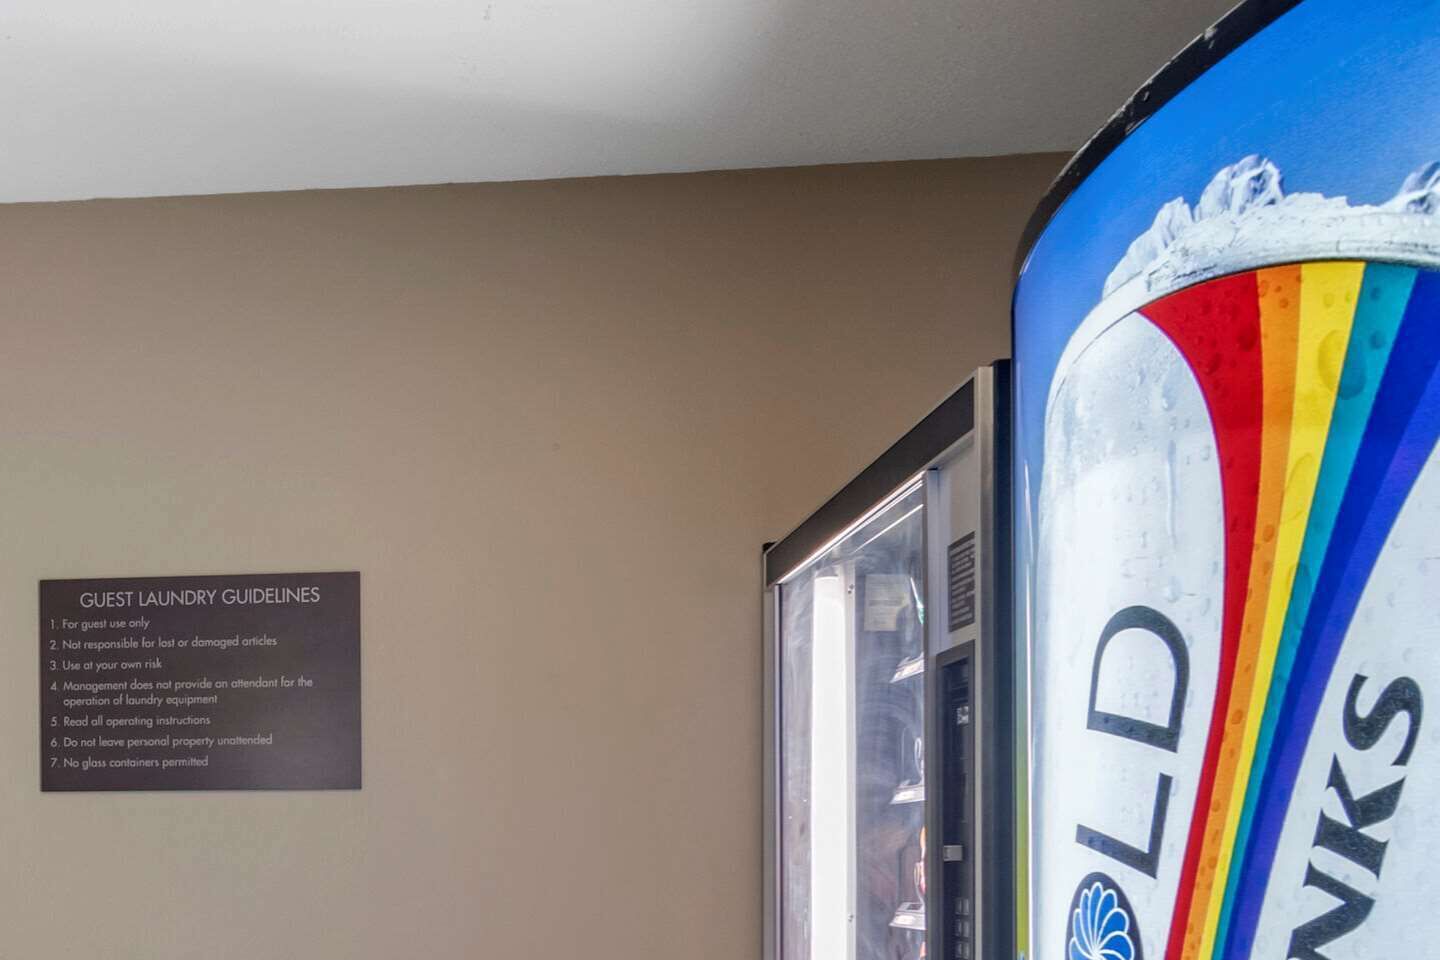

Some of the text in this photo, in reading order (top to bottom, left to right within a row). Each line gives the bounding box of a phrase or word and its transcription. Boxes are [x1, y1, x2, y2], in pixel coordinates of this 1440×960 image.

[80, 586, 320, 608] GUEST LAUNDRY GUIDELINES
[62, 619, 78, 629] For
[81, 619, 106, 631] guest
[110, 621, 127, 629] use
[128, 616, 150, 630] only
[62, 640, 81, 649] Not
[83, 637, 138, 651] responsible
[142, 636, 155, 648] for
[158, 636, 175, 648] lost
[191, 635, 239, 649] damaged
[242, 634, 278, 646] articles
[62, 660, 80, 670] Use
[83, 661, 93, 670] at
[96, 661, 117, 672] your
[121, 661, 142, 669] own
[145, 657, 162, 669] risk
[63, 681, 127, 693] Management
[130, 678, 153, 690] does
[156, 680, 172, 689] not
[175, 677, 212, 692] provide
[215, 680, 228, 688] an
[231, 675, 278, 688] attendant
[280, 676, 294, 687] for
[297, 675, 313, 687] the
[63, 694, 217, 708] operation of laundry equipment
[63, 715, 88, 726] Read
[91, 715, 103, 726] all
[106, 716, 153, 728] operating
[156, 716, 211, 725] instructions
[63, 737, 78, 747] Do
[81, 738, 96, 747] not
[99, 736, 124, 747] leave
[127, 735, 169, 748] personal
[172, 737, 214, 748] property
[217, 733, 272, 745] unattended
[63, 758, 79, 768] No
[82, 756, 106, 770] glass
[109, 757, 159, 768] containers
[162, 755, 208, 769] permitted
